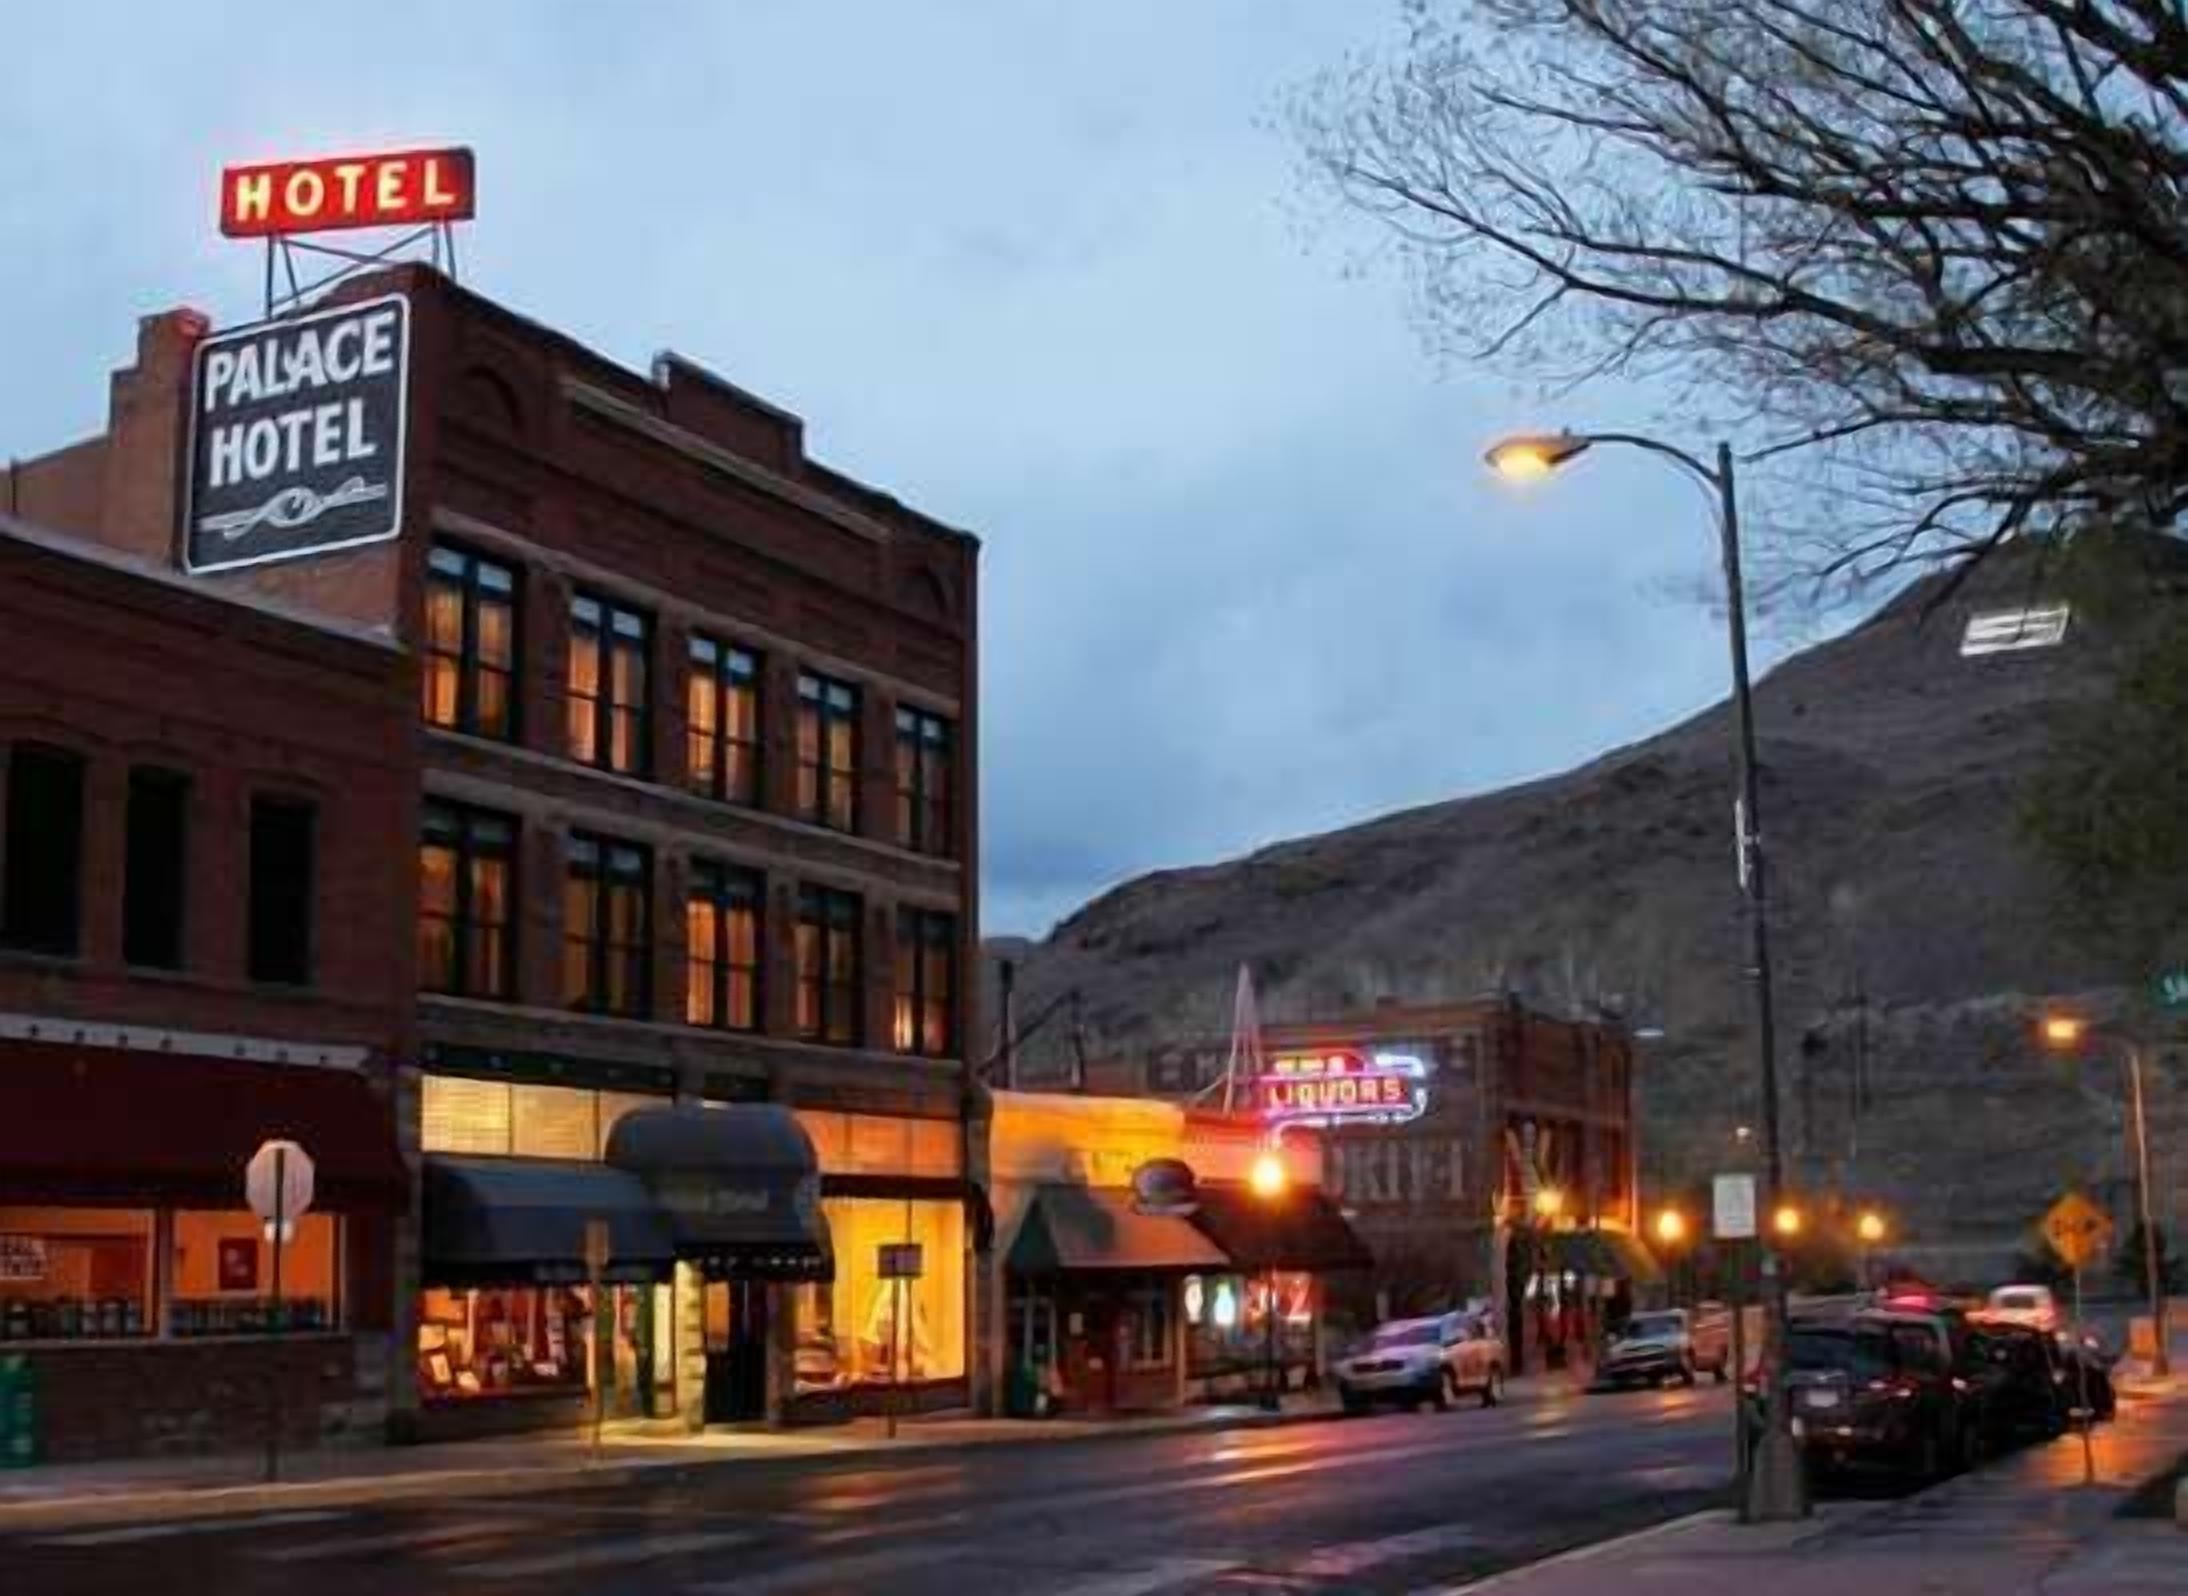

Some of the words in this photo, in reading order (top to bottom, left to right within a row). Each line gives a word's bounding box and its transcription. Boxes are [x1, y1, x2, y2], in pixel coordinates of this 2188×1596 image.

[235, 159, 455, 222] HOTEL
[204, 311, 396, 411] PALACE
[209, 398, 377, 487] HOTEL
[1268, 1077, 1402, 1109] LIQUORS
